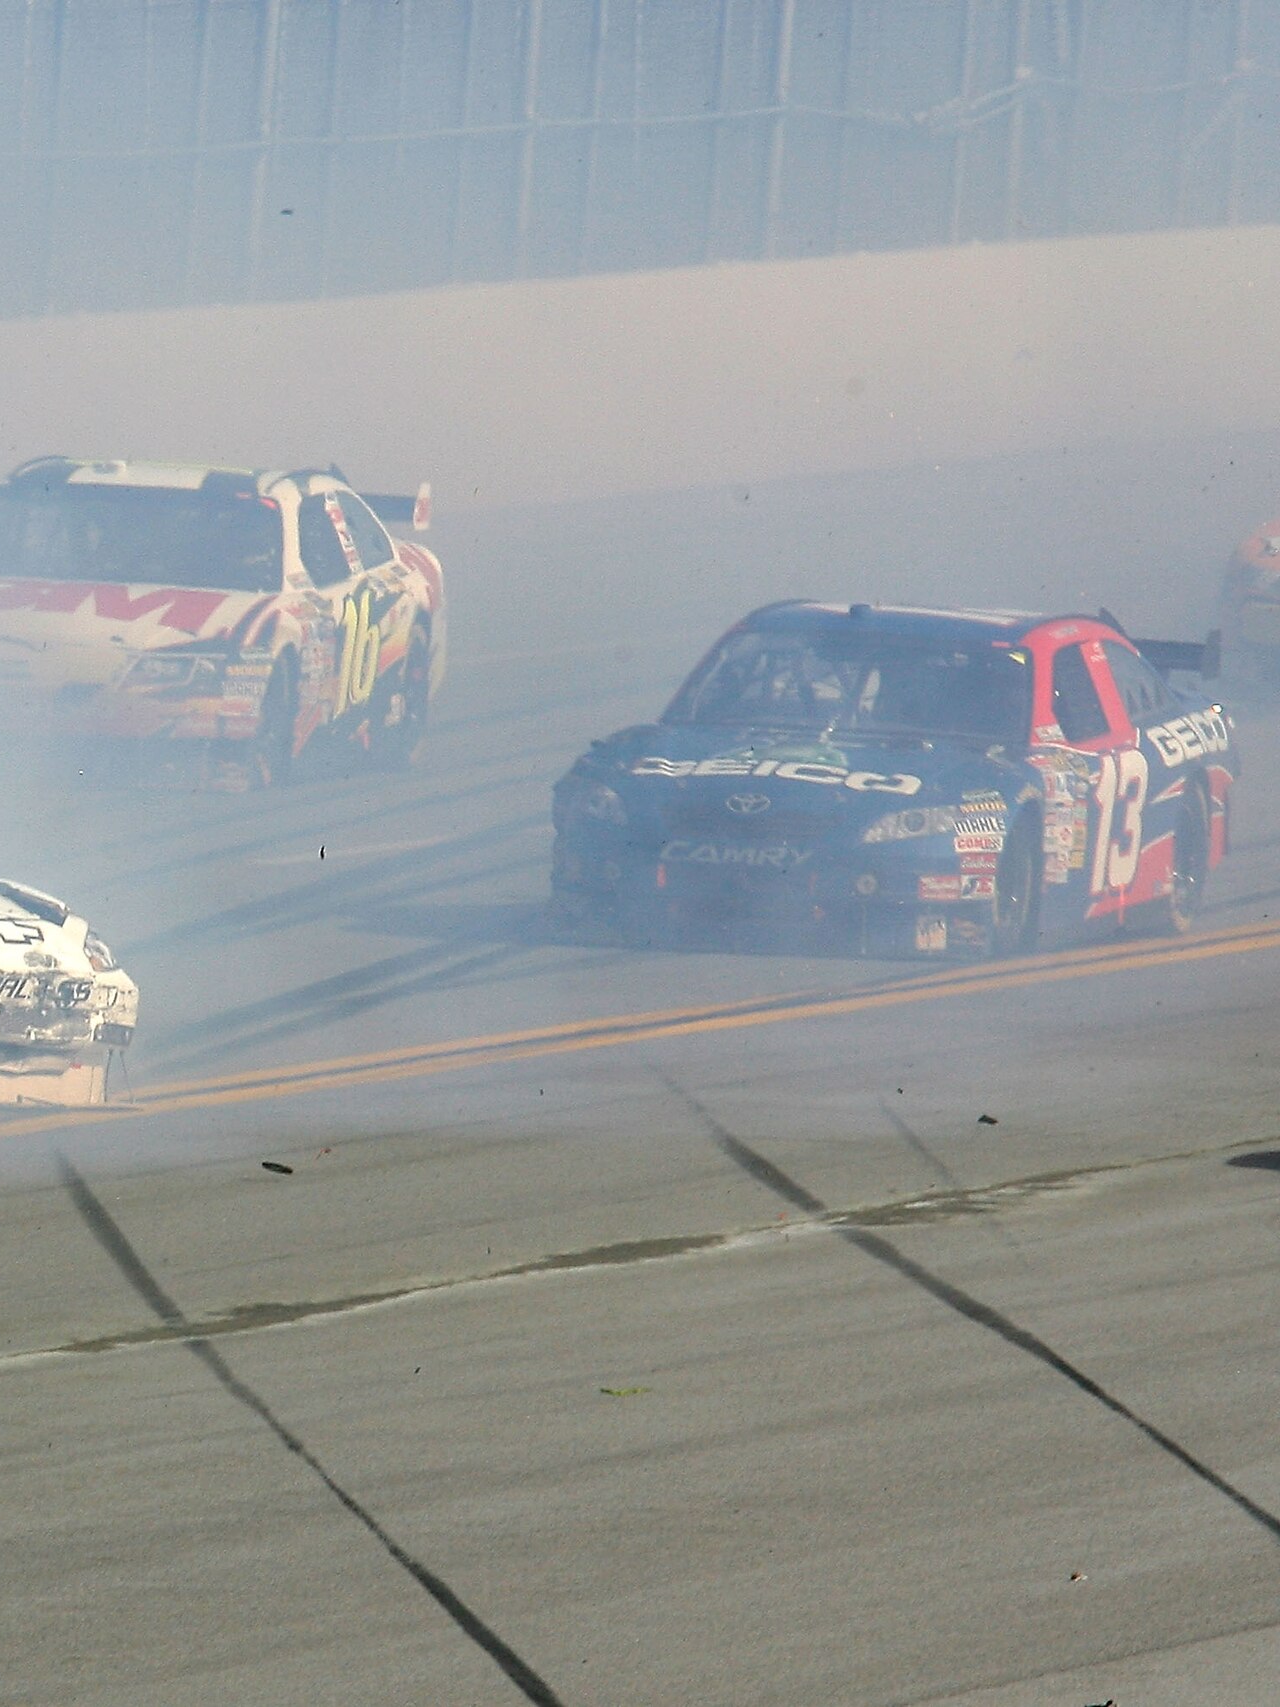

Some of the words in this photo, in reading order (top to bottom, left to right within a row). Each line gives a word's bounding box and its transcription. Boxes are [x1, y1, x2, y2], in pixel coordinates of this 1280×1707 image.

[333, 590, 381, 720] 16
[659, 840, 814, 867] CAMRY
[1090, 749, 1149, 896] 13
